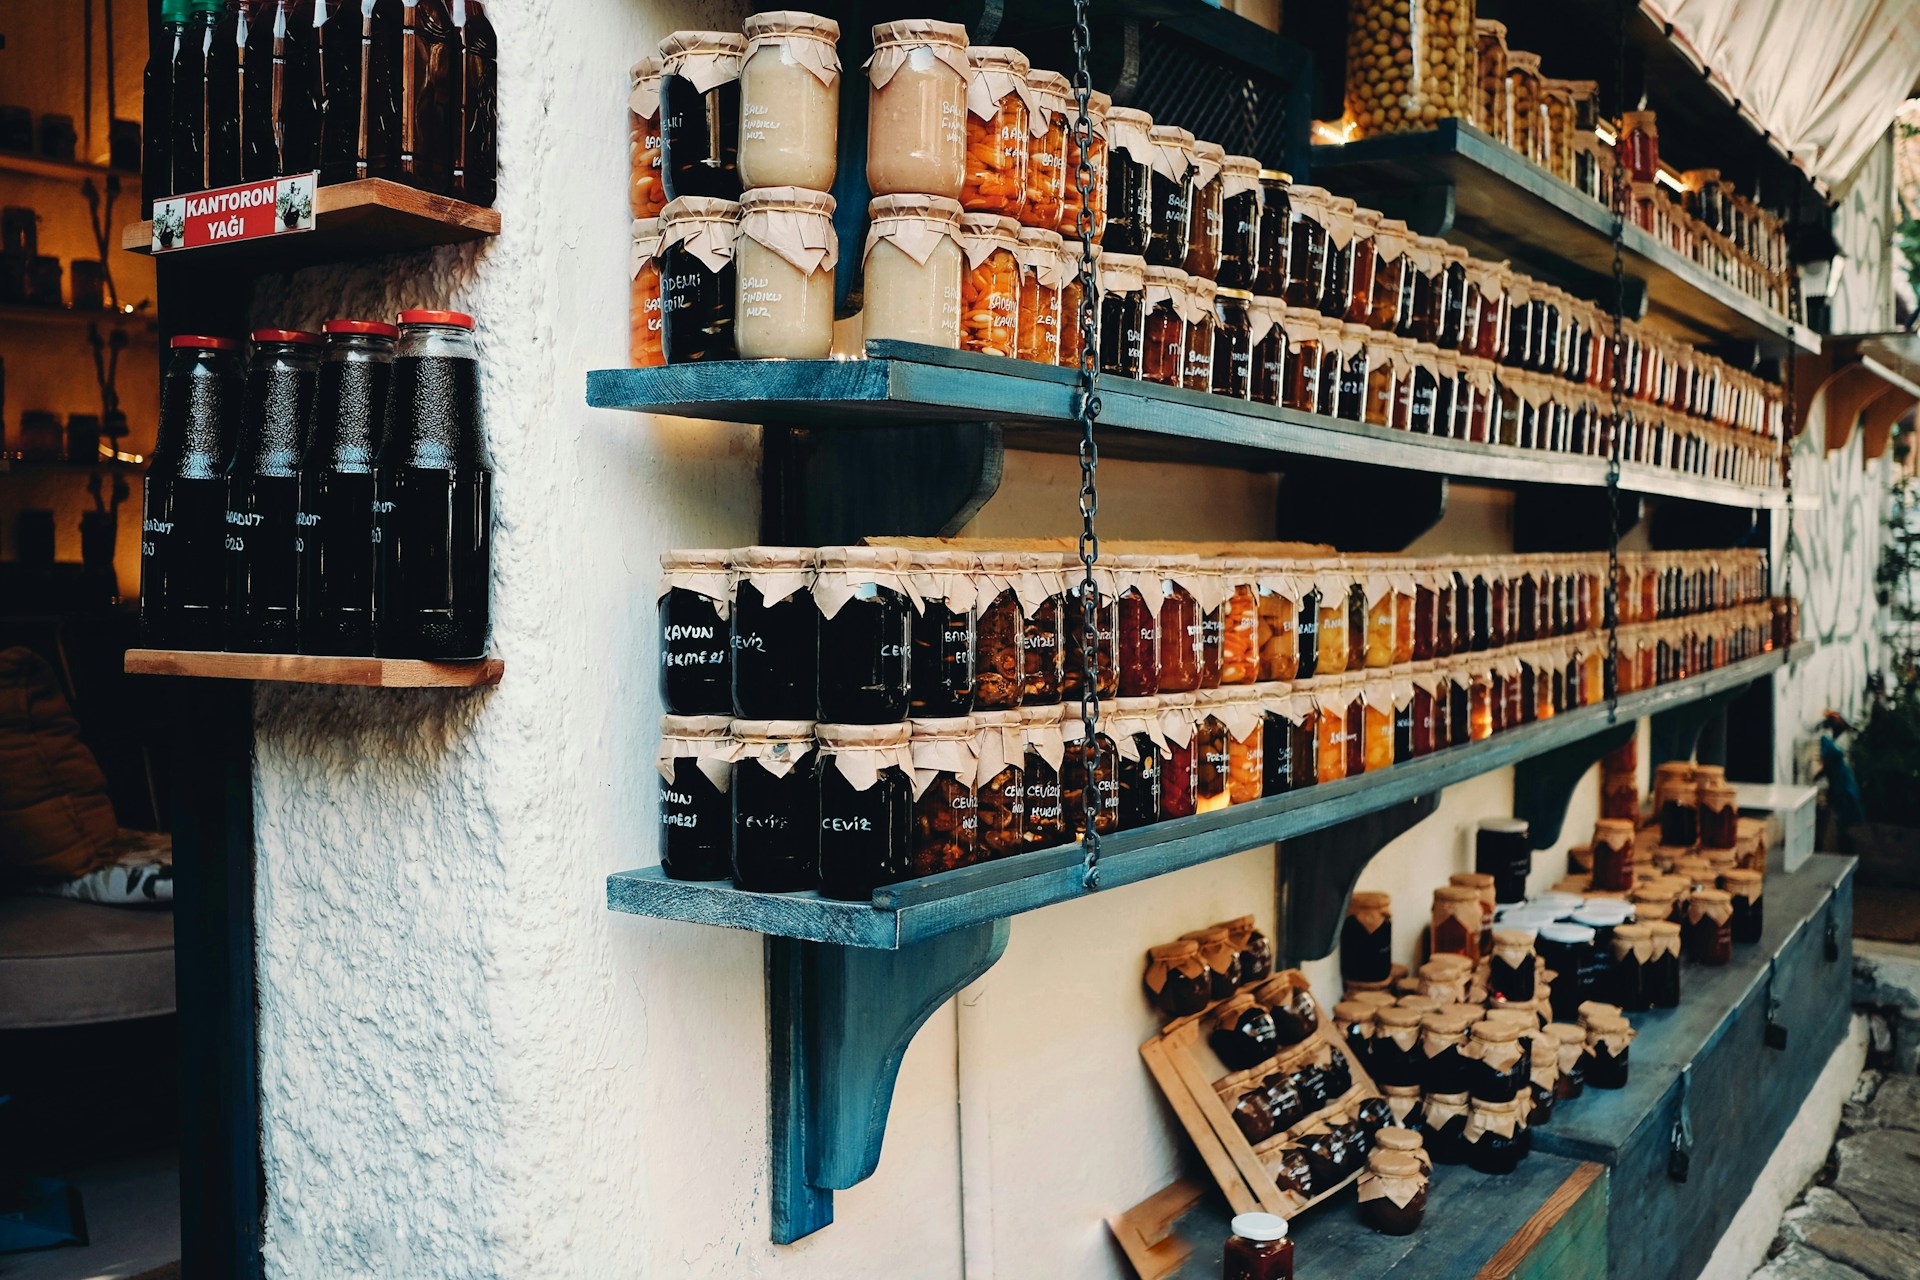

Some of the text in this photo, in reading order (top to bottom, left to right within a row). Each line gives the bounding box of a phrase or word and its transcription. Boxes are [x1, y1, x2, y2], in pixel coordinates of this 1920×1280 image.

[186, 185, 275, 218] KANTORON
[207, 214, 244, 240] YAĞI
[664, 624, 714, 642] KAVUN
[822, 816, 872, 831] CEVİZ
